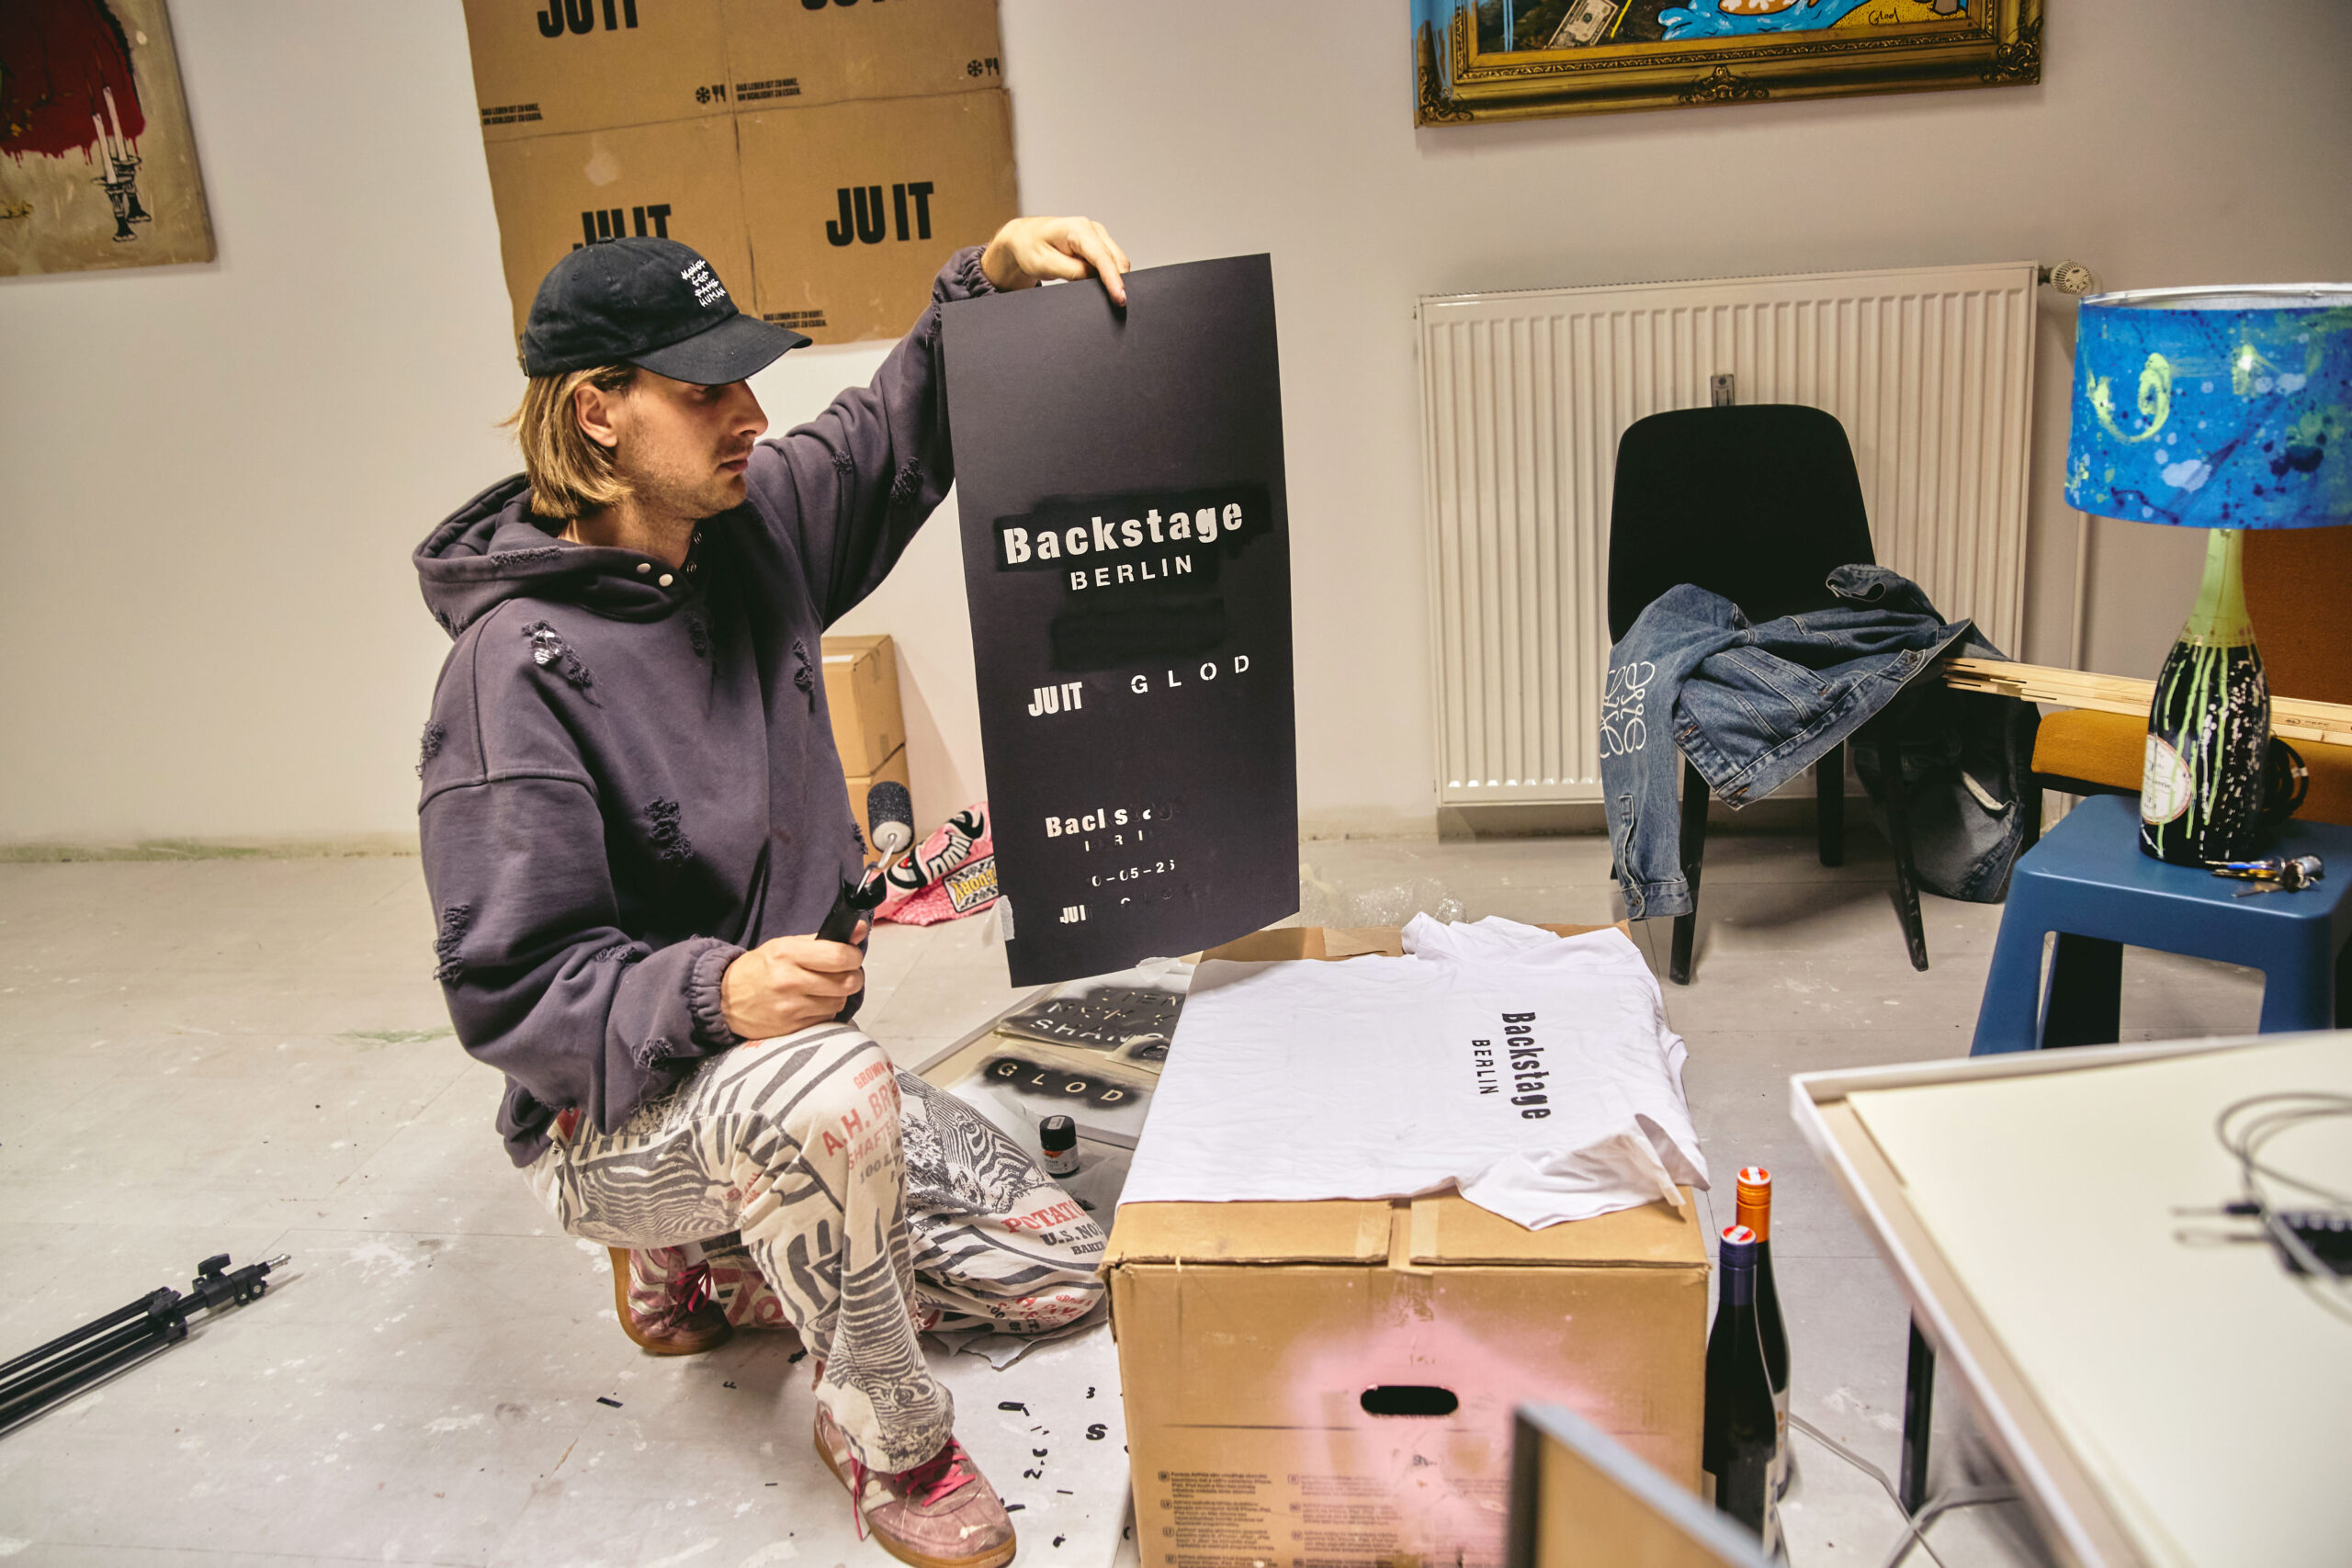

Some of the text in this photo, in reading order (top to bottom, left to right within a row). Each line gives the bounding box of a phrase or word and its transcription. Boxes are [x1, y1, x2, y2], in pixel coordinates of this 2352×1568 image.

[698, 287, 726, 307] HUMAN
[1003, 502, 1242, 565] Backstage
[1070, 554, 1192, 591] BERLIN
[1472, 1040, 1498, 1094] BERLIN
[1501, 1012, 1551, 1119] Backstage
